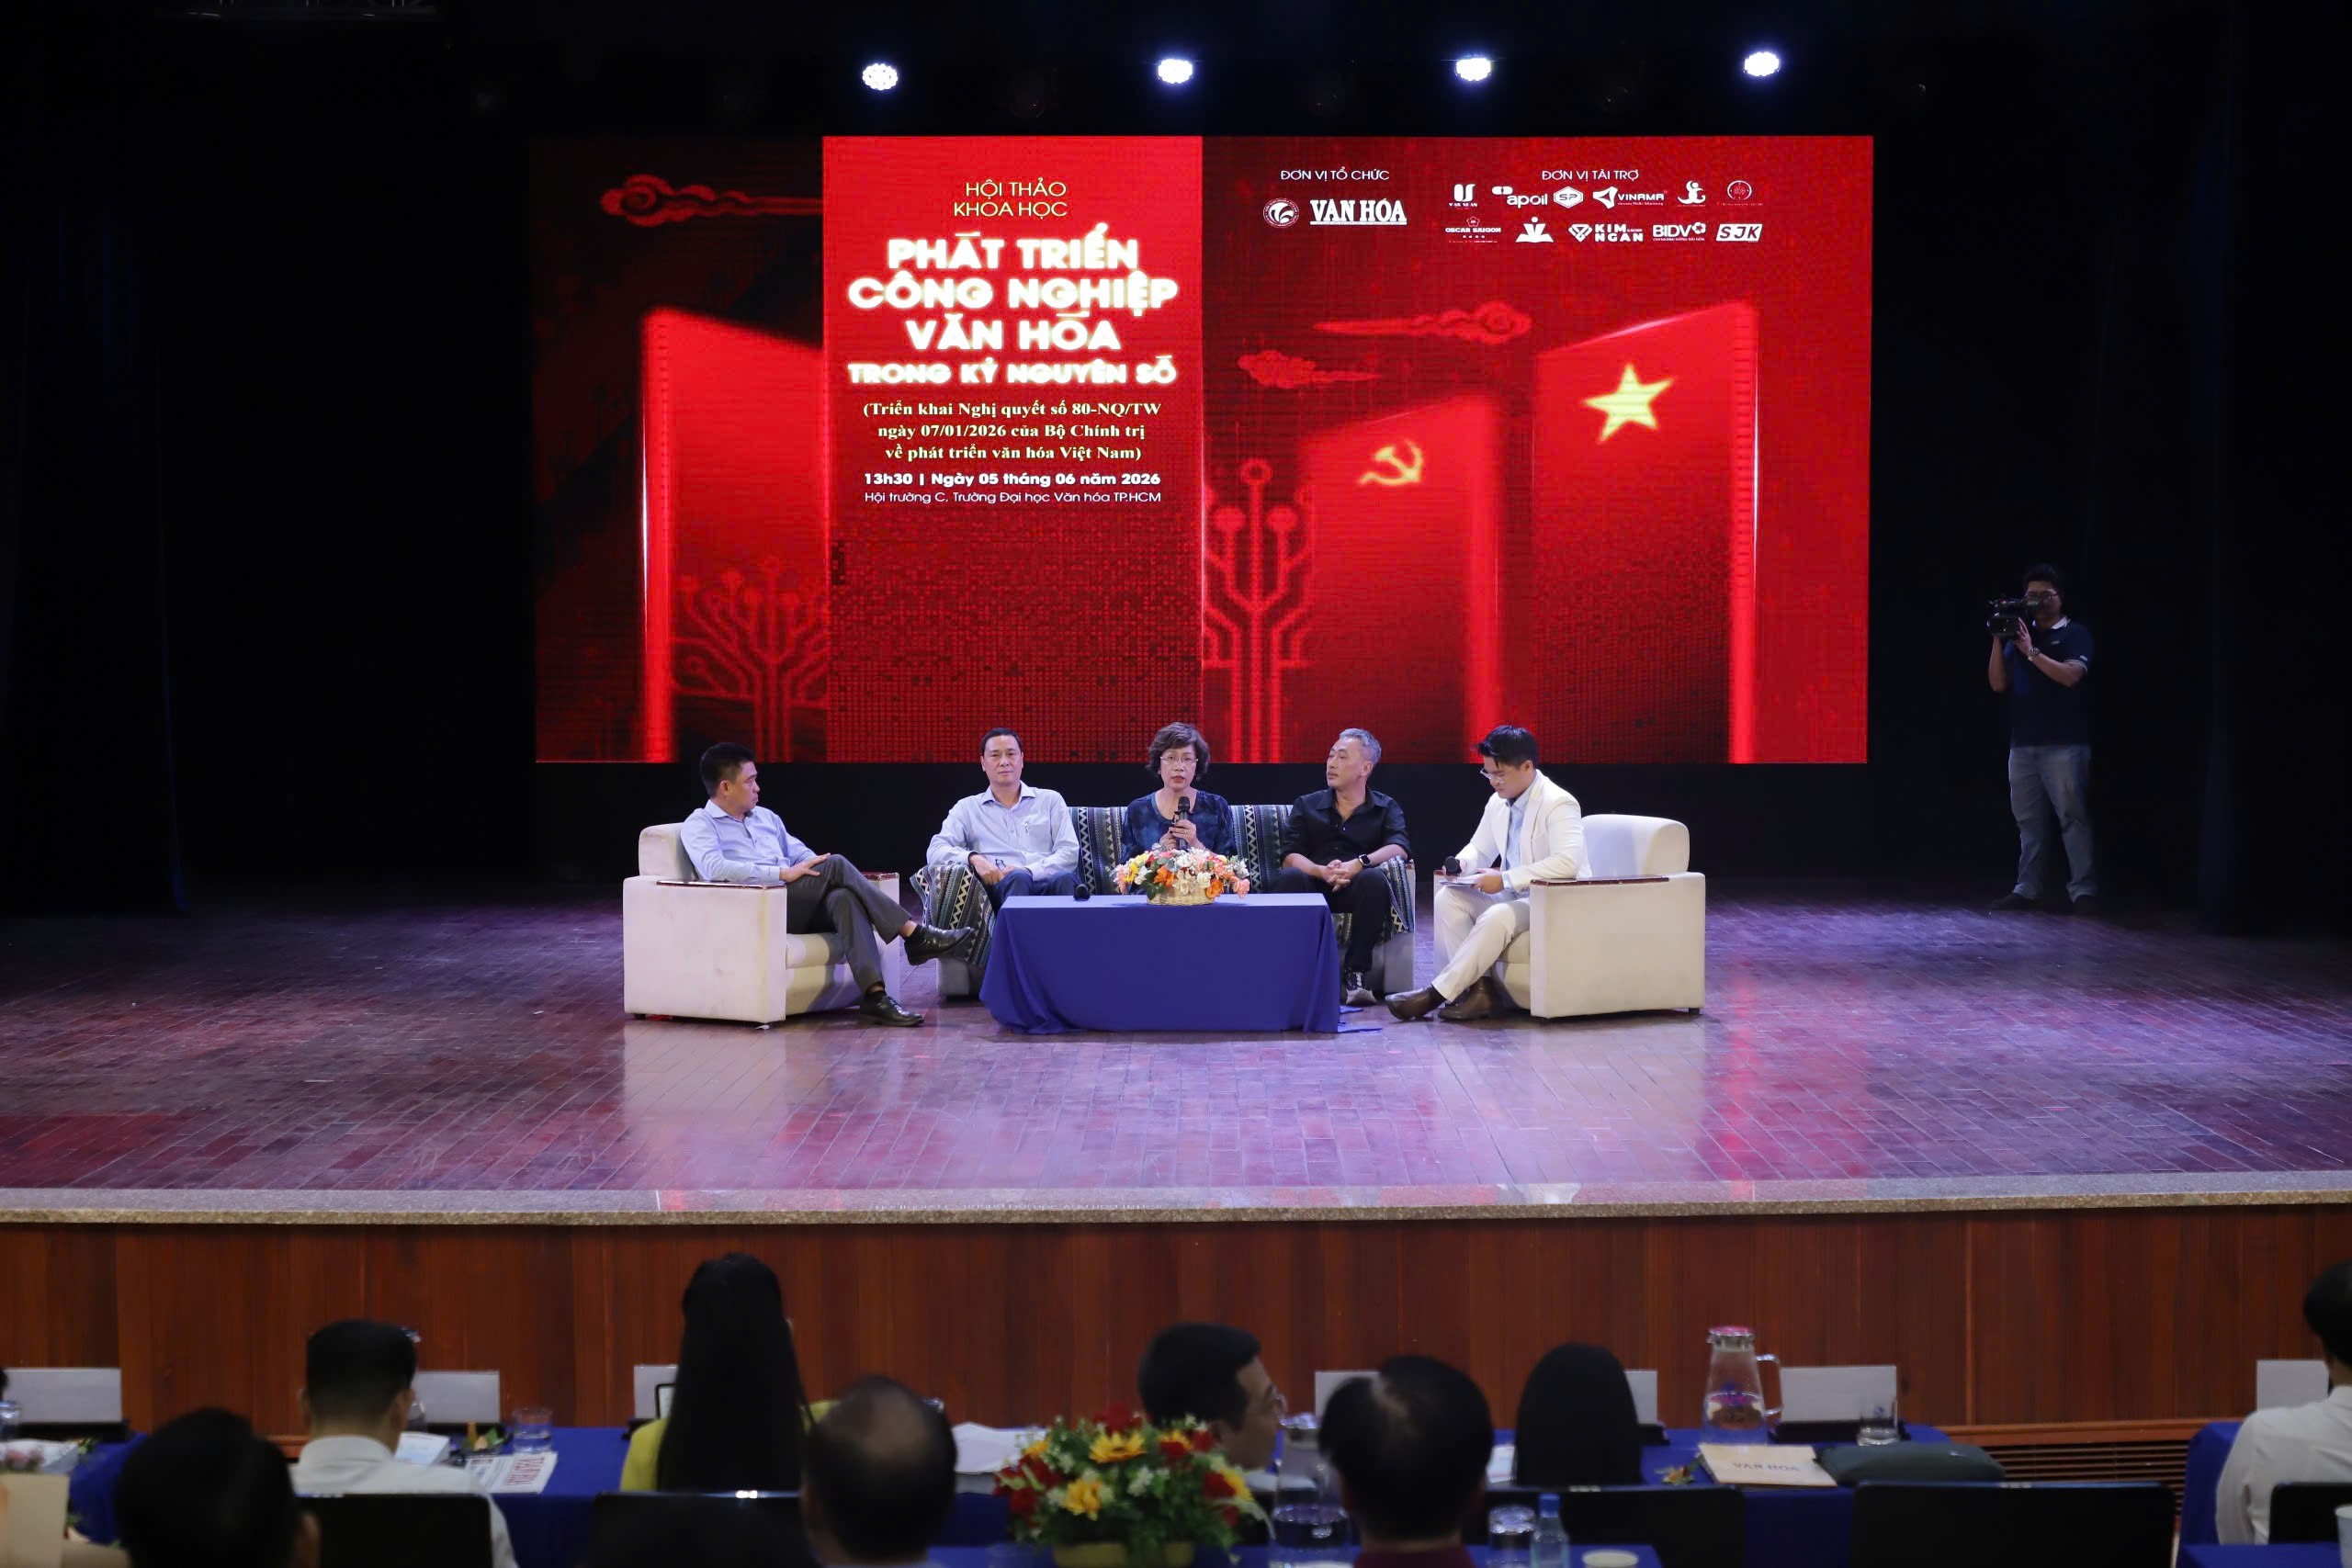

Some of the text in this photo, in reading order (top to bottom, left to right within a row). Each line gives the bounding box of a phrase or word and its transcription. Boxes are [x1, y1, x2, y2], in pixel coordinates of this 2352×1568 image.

[1281, 166, 1389, 182] ĐƠN VỊ TỔ CHỨC
[1542, 169, 1639, 182] ĐƠN VỊ TÀI TRỢ
[967, 177, 1067, 200] HỘI THẢO
[954, 202, 1068, 220] KHOA HỌC
[1595, 224, 1626, 232] KIM
[1653, 225, 1692, 237] BIDV
[1720, 227, 1758, 239] SJK
[1017, 222, 1137, 268] TRIỂN
[1595, 233, 1643, 242] NGAN
[849, 270, 1178, 316] CÔNG NGHIỆP
[906, 311, 1121, 349] VĂN HÓA
[848, 355, 1176, 384] TRONG KỶ NGUYÊN SỐ
[864, 400, 1160, 418] (Triển khai Nghị quyết số 80-NQ/TW
[878, 424, 1145, 440] ngày 07/01/2026 của Bộ Chính trị
[886, 444, 1141, 461] về phát triển văn hóa Việt Nam)
[865, 474, 912, 485] 13h30
[932, 474, 974, 487] Ngày
[979, 474, 998, 485] 05
[1003, 473, 1050, 487] tháng
[1056, 474, 1075, 485] 06
[1080, 474, 1116, 485] năm
[1122, 474, 1160, 485] 2026
[865, 491, 885, 503] Hội
[889, 492, 931, 504] trường
[954, 492, 996, 504] Trường
[1001, 492, 1021, 503] Đại
[1025, 492, 1050, 504] học
[1055, 492, 1080, 502] Văn
[1084, 492, 1110, 502] hóa
[1114, 492, 1160, 502] TP.HCM
